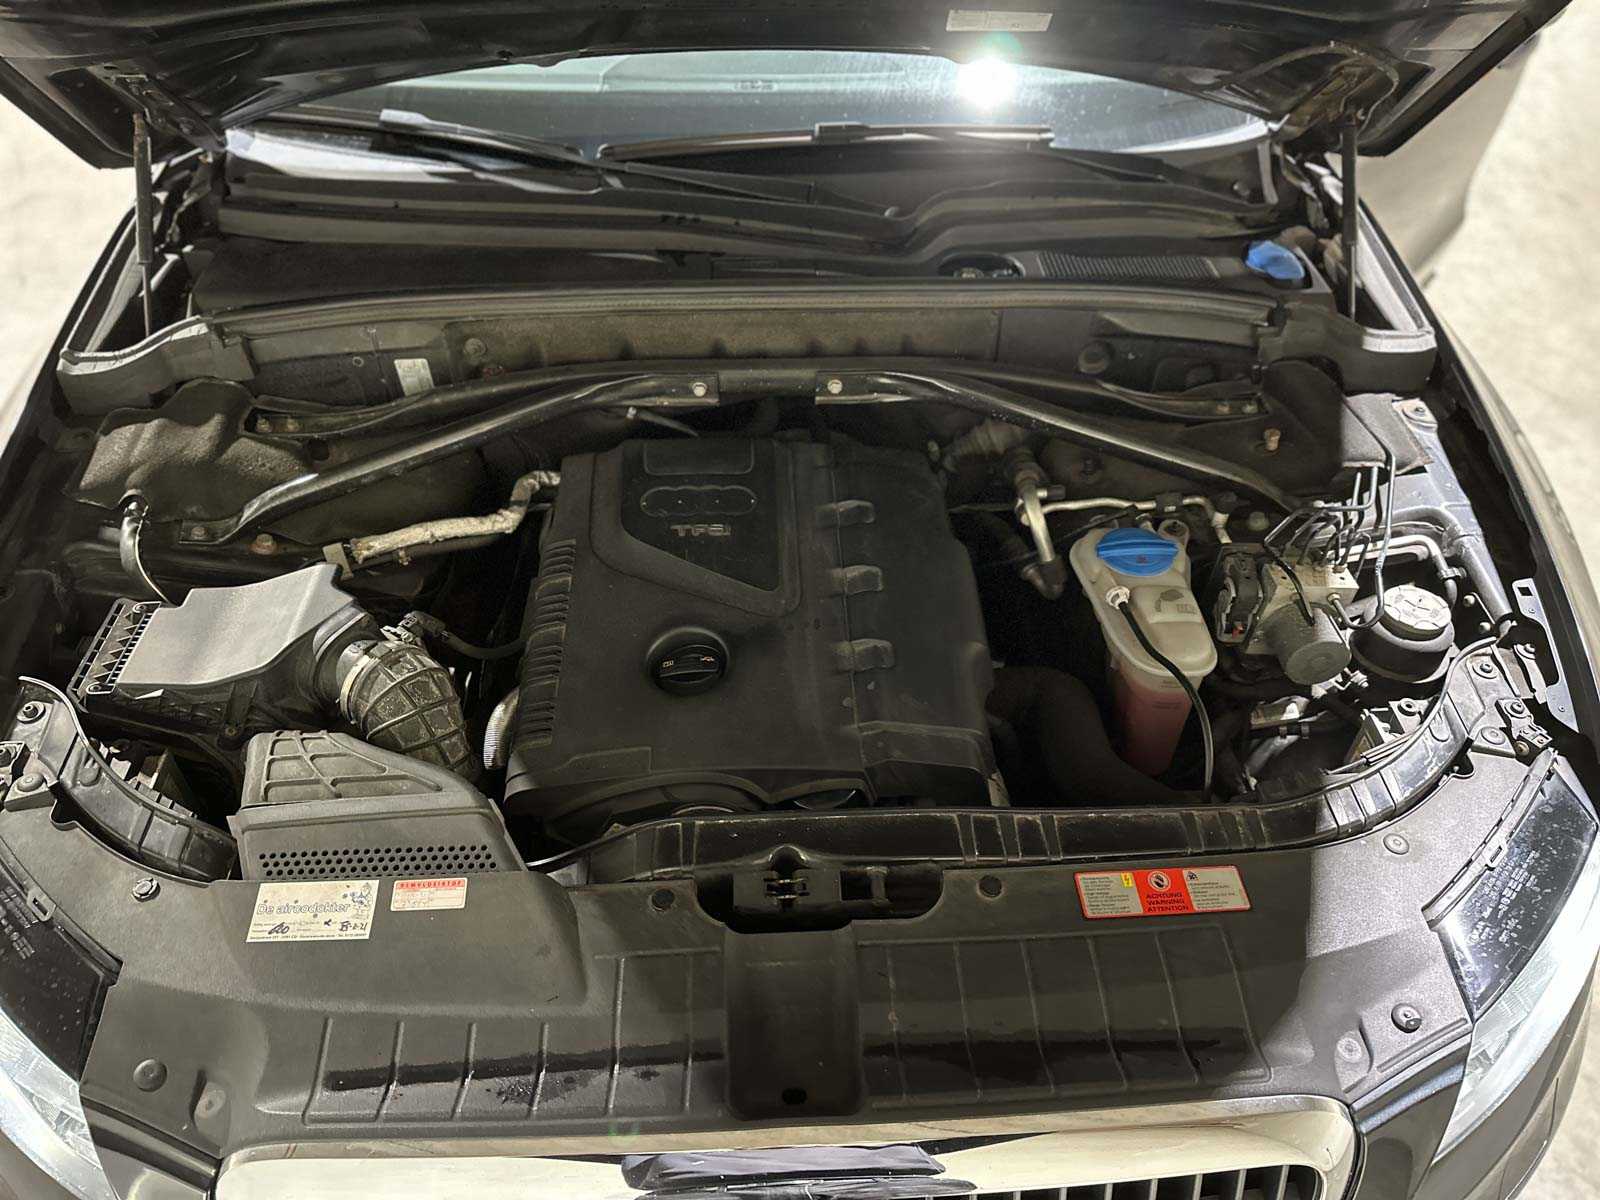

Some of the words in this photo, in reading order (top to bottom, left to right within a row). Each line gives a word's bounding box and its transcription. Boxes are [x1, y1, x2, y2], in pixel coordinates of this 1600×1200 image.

[1146, 891, 1183, 899] ACHTUNG
[1146, 898, 1185, 906] WARNING
[256, 903, 275, 915] De
[276, 902, 351, 914] aircodokter
[1147, 905, 1189, 913] ATTENTION
